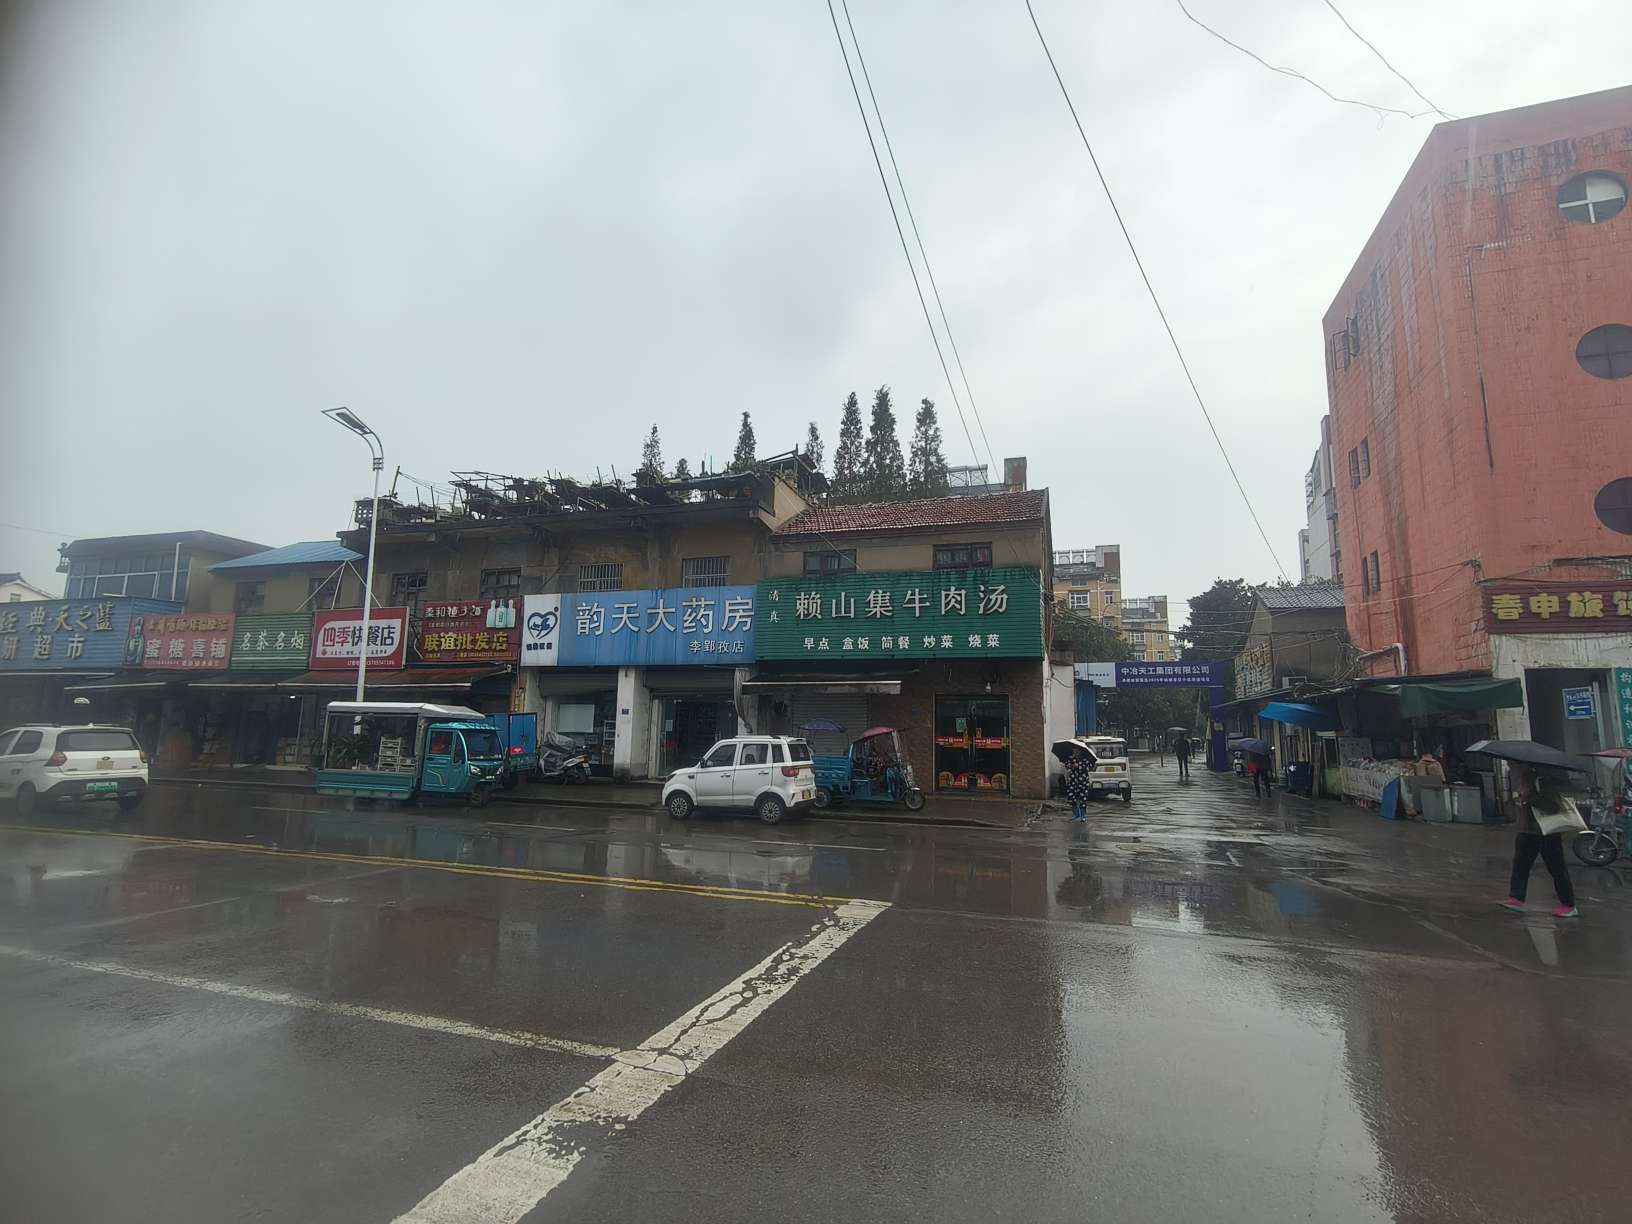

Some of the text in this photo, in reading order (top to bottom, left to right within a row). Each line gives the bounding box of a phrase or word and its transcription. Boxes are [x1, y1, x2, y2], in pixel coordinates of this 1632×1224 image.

[795, 584, 1009, 620] 赖山集牛肉汤
[575, 595, 755, 636] 韵天大药房
[322, 625, 396, 647] 四季快餐店
[423, 631, 509, 652] 联谊批发店
[688, 639, 745, 654] 李郢孜店
[802, 634, 1001, 651] 早点 盒饭 简餐 炒菜 烧菜
